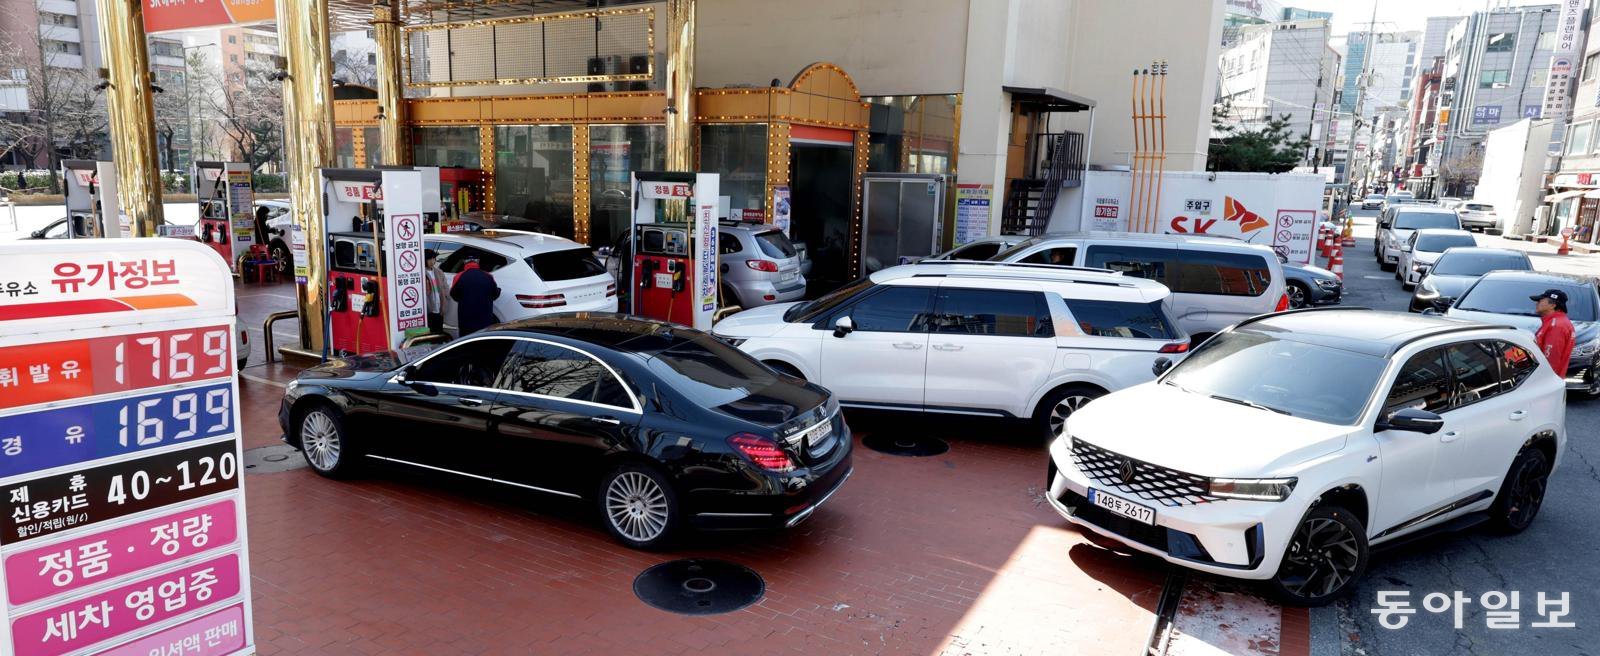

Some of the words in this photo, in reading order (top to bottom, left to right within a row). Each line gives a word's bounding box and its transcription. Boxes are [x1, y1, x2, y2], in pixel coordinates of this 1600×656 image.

[1186, 200, 1210, 210] 주입구
[1170, 216, 1217, 233] SK
[52, 259, 180, 293] 유가정보
[115, 329, 228, 385] 1769
[119, 388, 229, 447] 1699
[12, 493, 89, 523] 신용카드
[1124, 503, 1151, 521] 2617
[38, 540, 112, 586] 정품
[150, 514, 213, 556] 정량
[42, 600, 114, 642] 세차
[125, 568, 218, 621] 영업중
[205, 620, 237, 648] 판매
